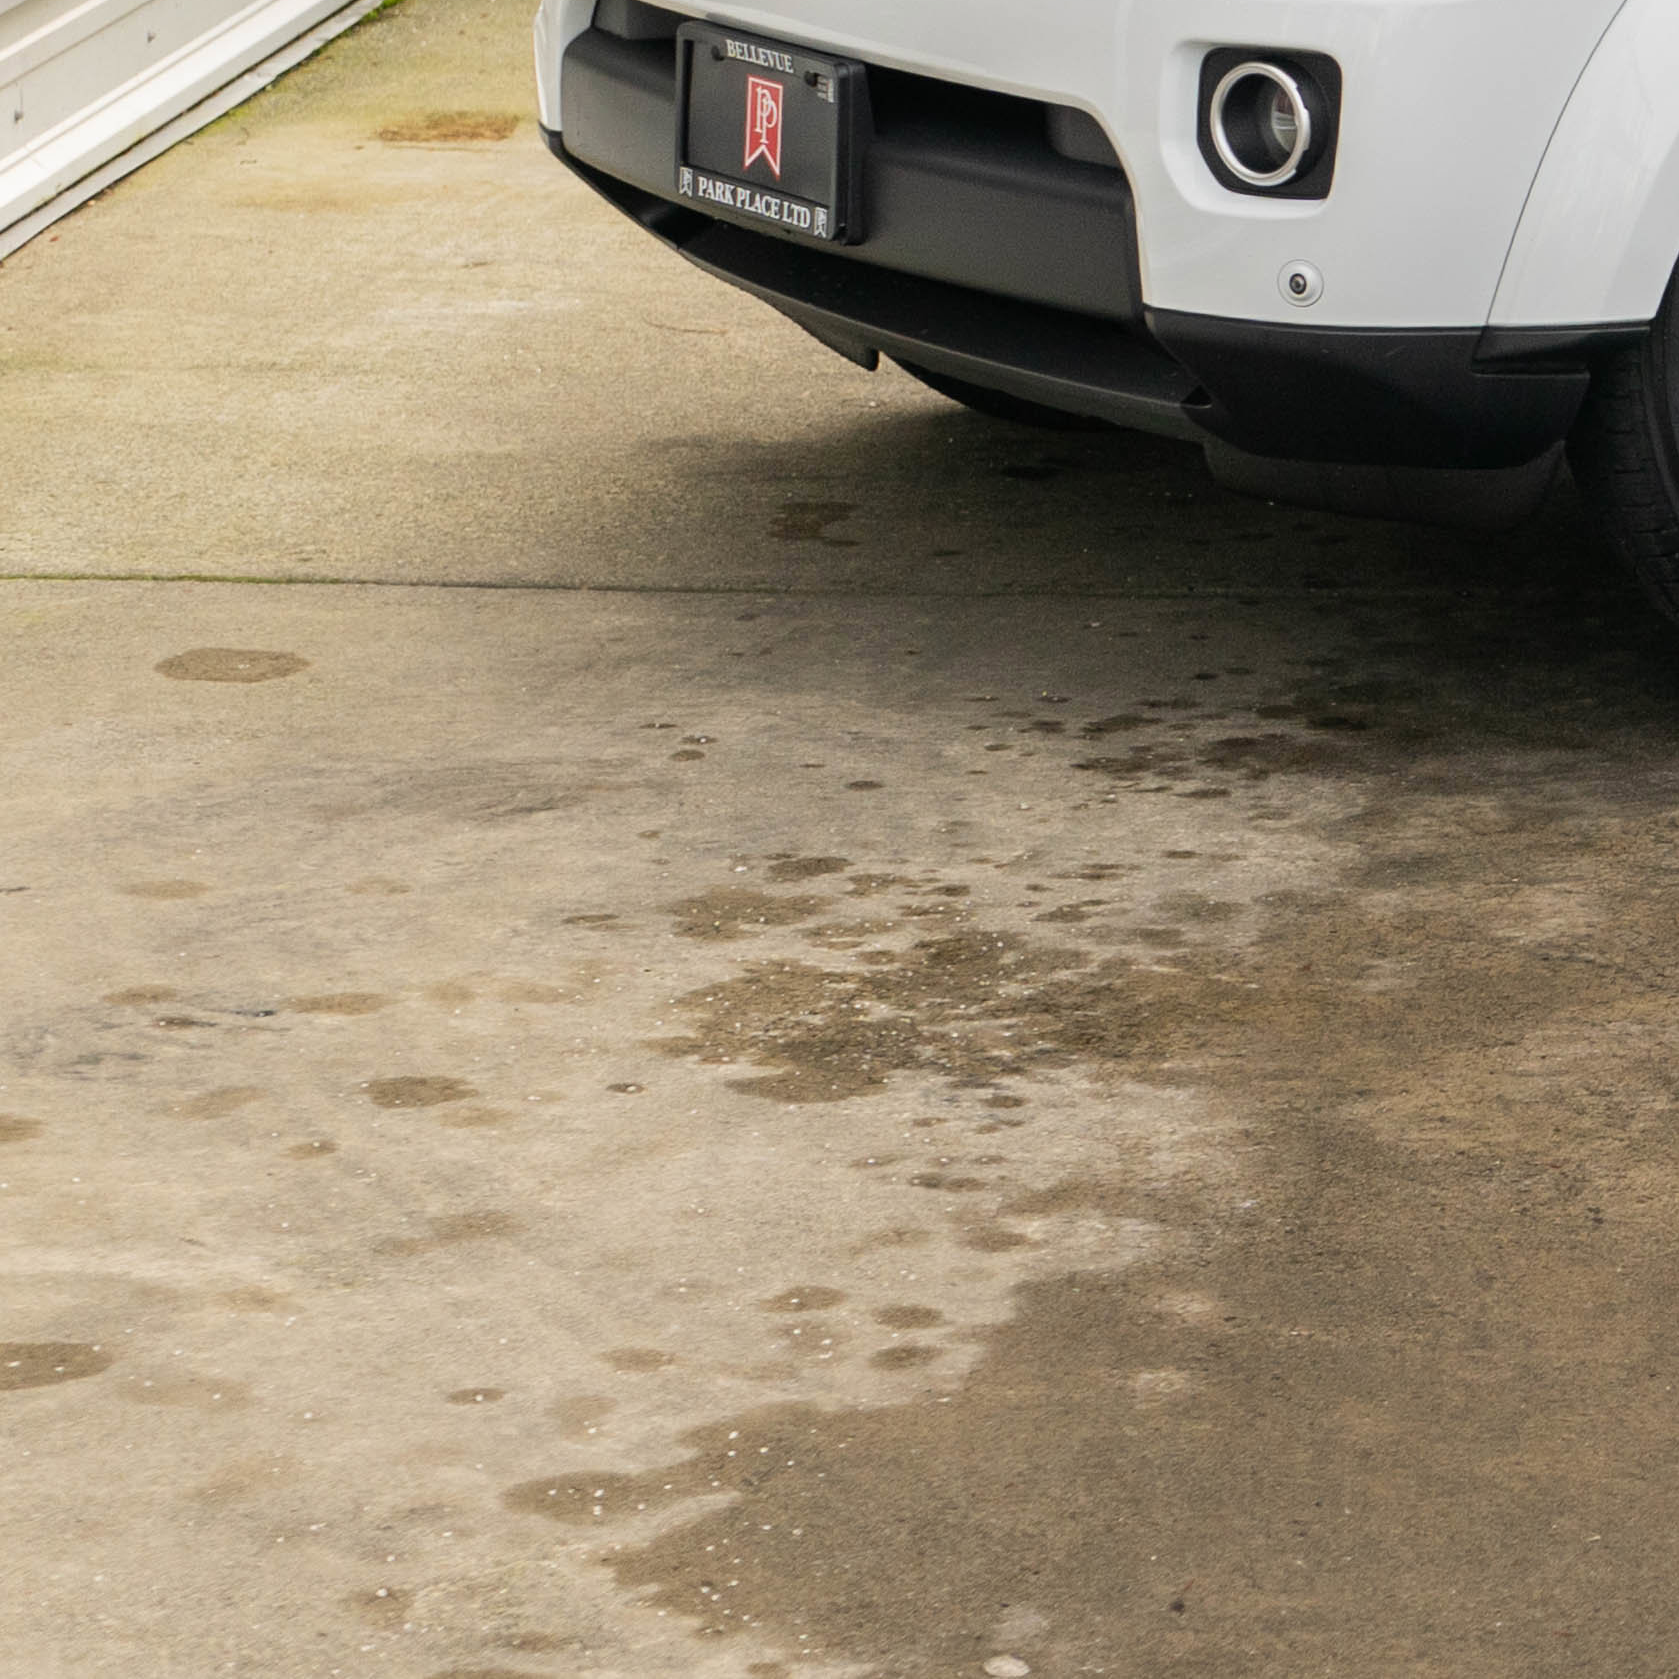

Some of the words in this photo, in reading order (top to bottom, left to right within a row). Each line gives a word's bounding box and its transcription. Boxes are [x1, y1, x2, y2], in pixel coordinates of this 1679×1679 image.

[724, 39, 794, 74] BELLEVUE
[697, 176, 735, 205] PARK
[736, 187, 781, 220] PLACE
[782, 201, 811, 228] LTD
